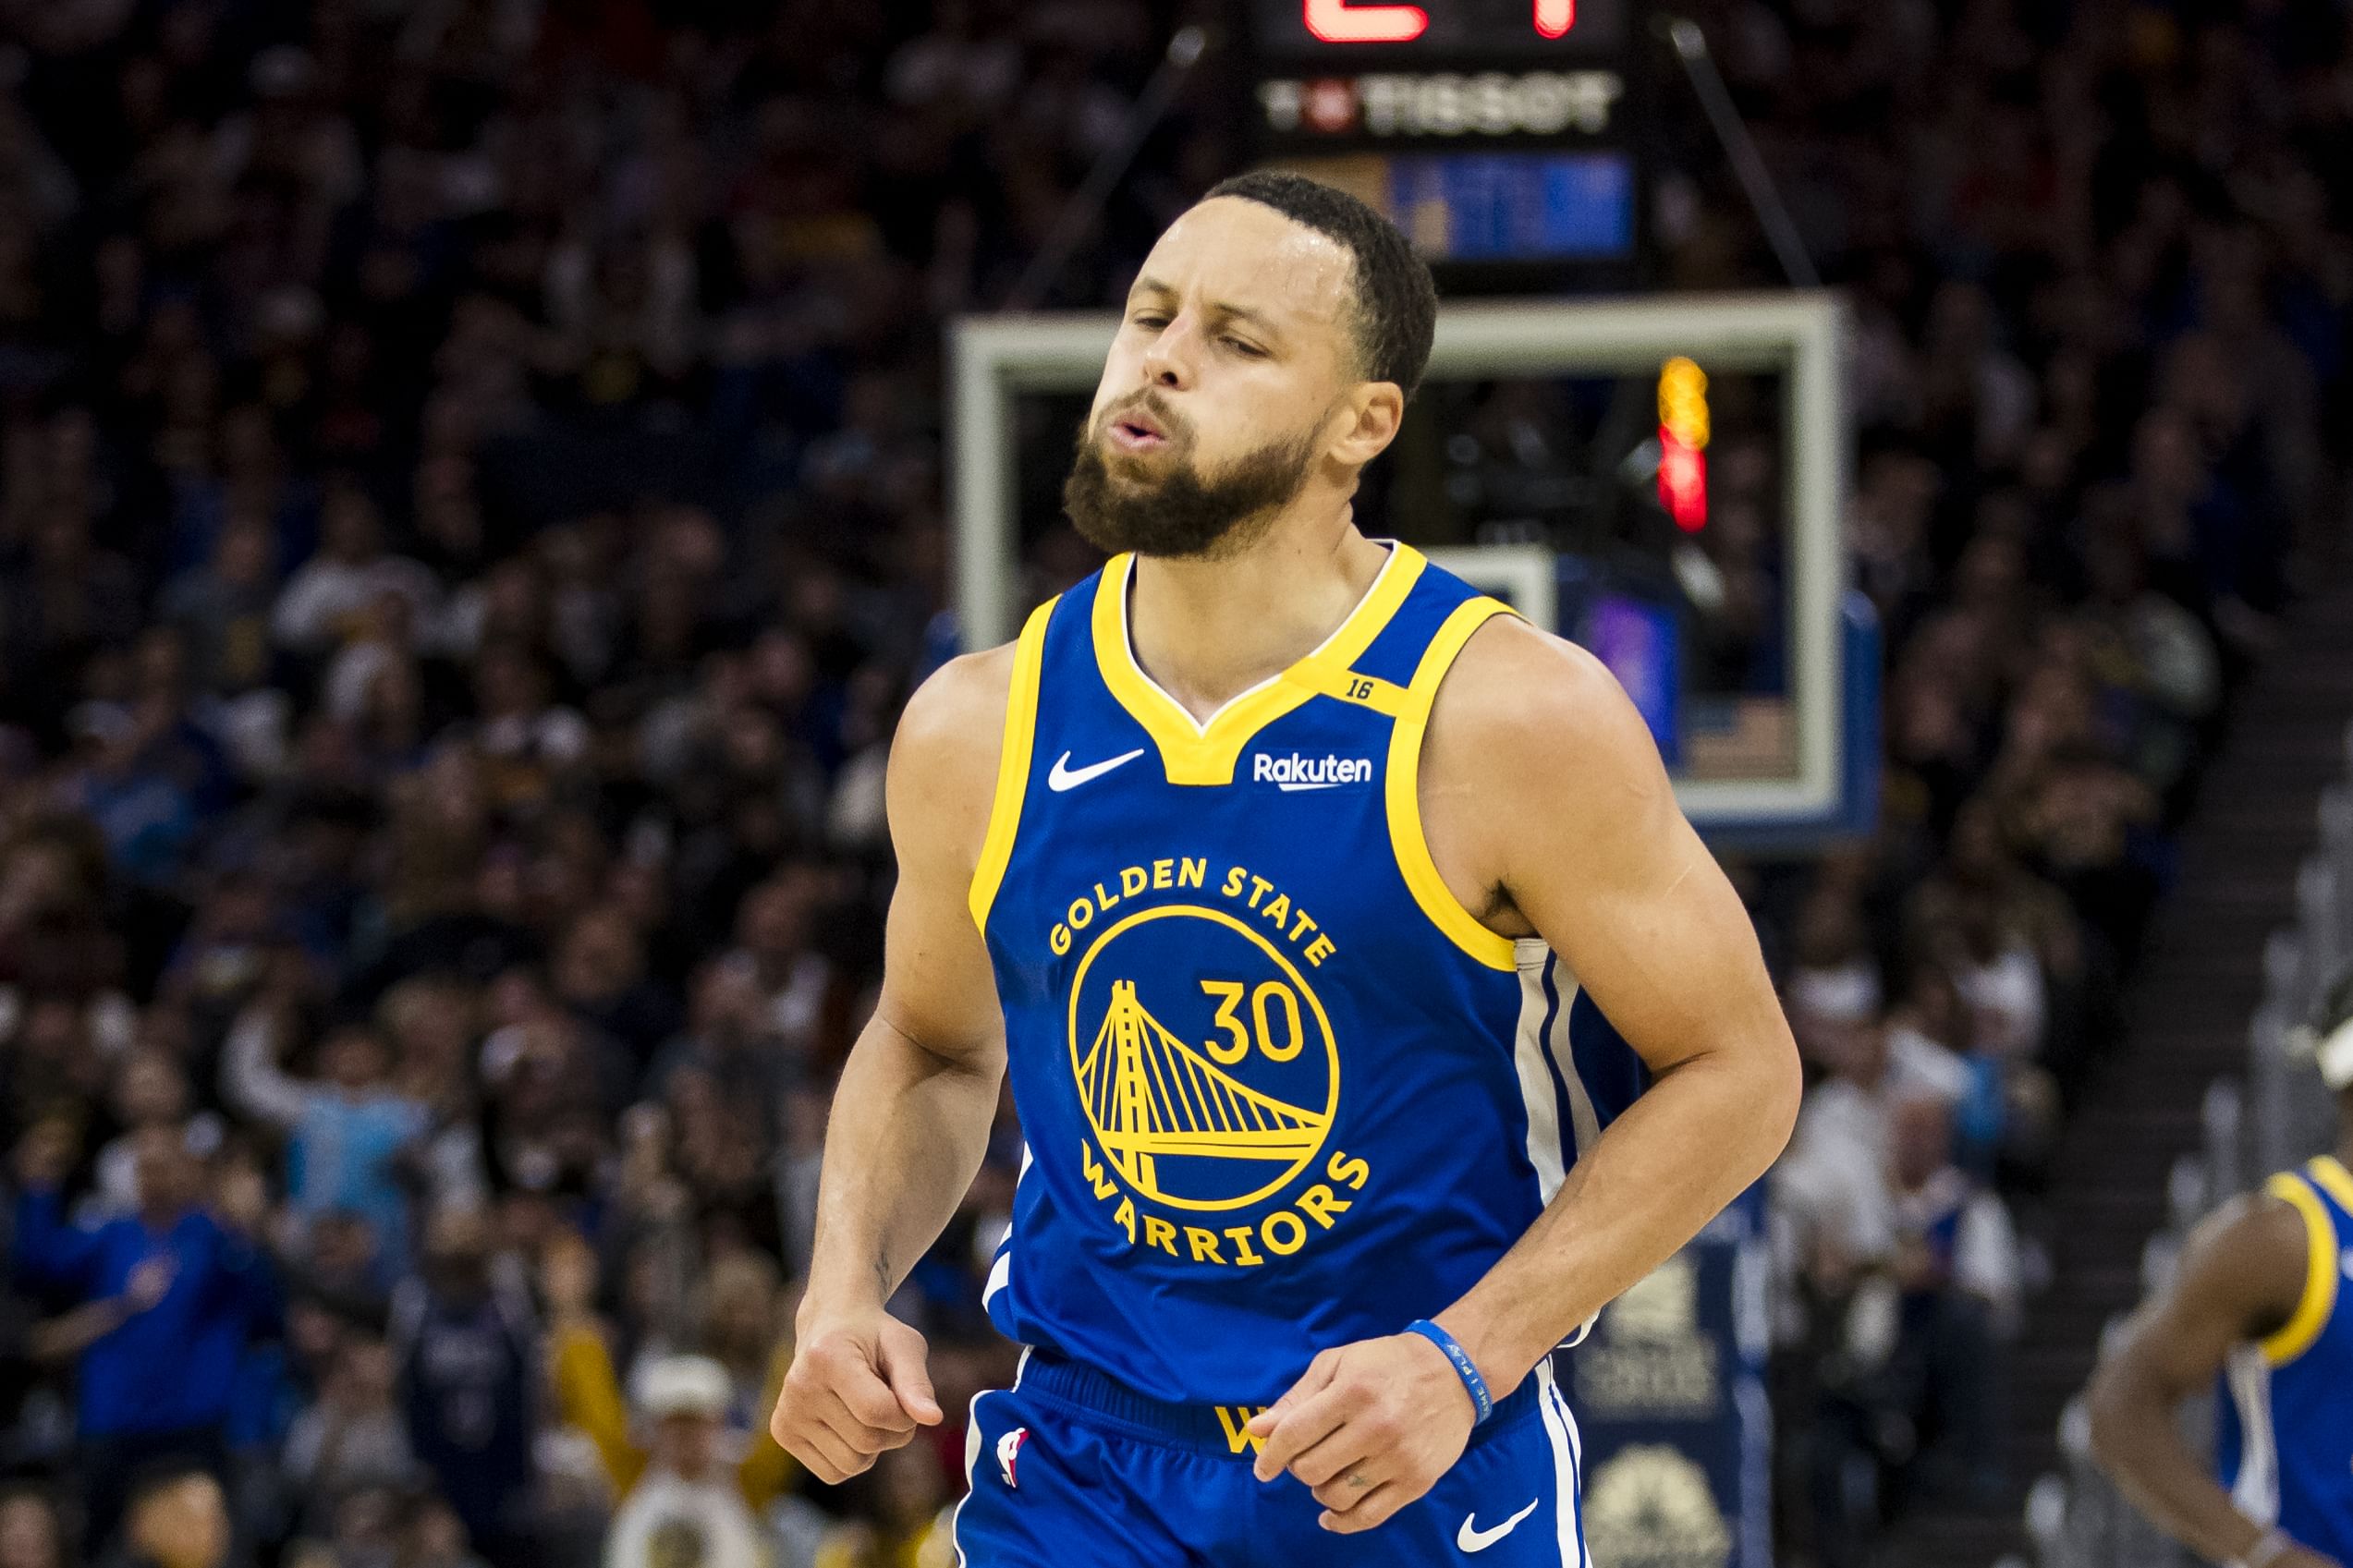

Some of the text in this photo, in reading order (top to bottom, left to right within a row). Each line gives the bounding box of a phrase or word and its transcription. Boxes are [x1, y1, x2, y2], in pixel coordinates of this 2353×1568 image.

[1346, 677, 1374, 701] 16
[1253, 752, 1372, 784] Rakuten
[1050, 857, 1337, 968] GOLDEN STATE
[1200, 979, 1305, 1064] 30
[1081, 1137, 1370, 1266] WARRIORS
